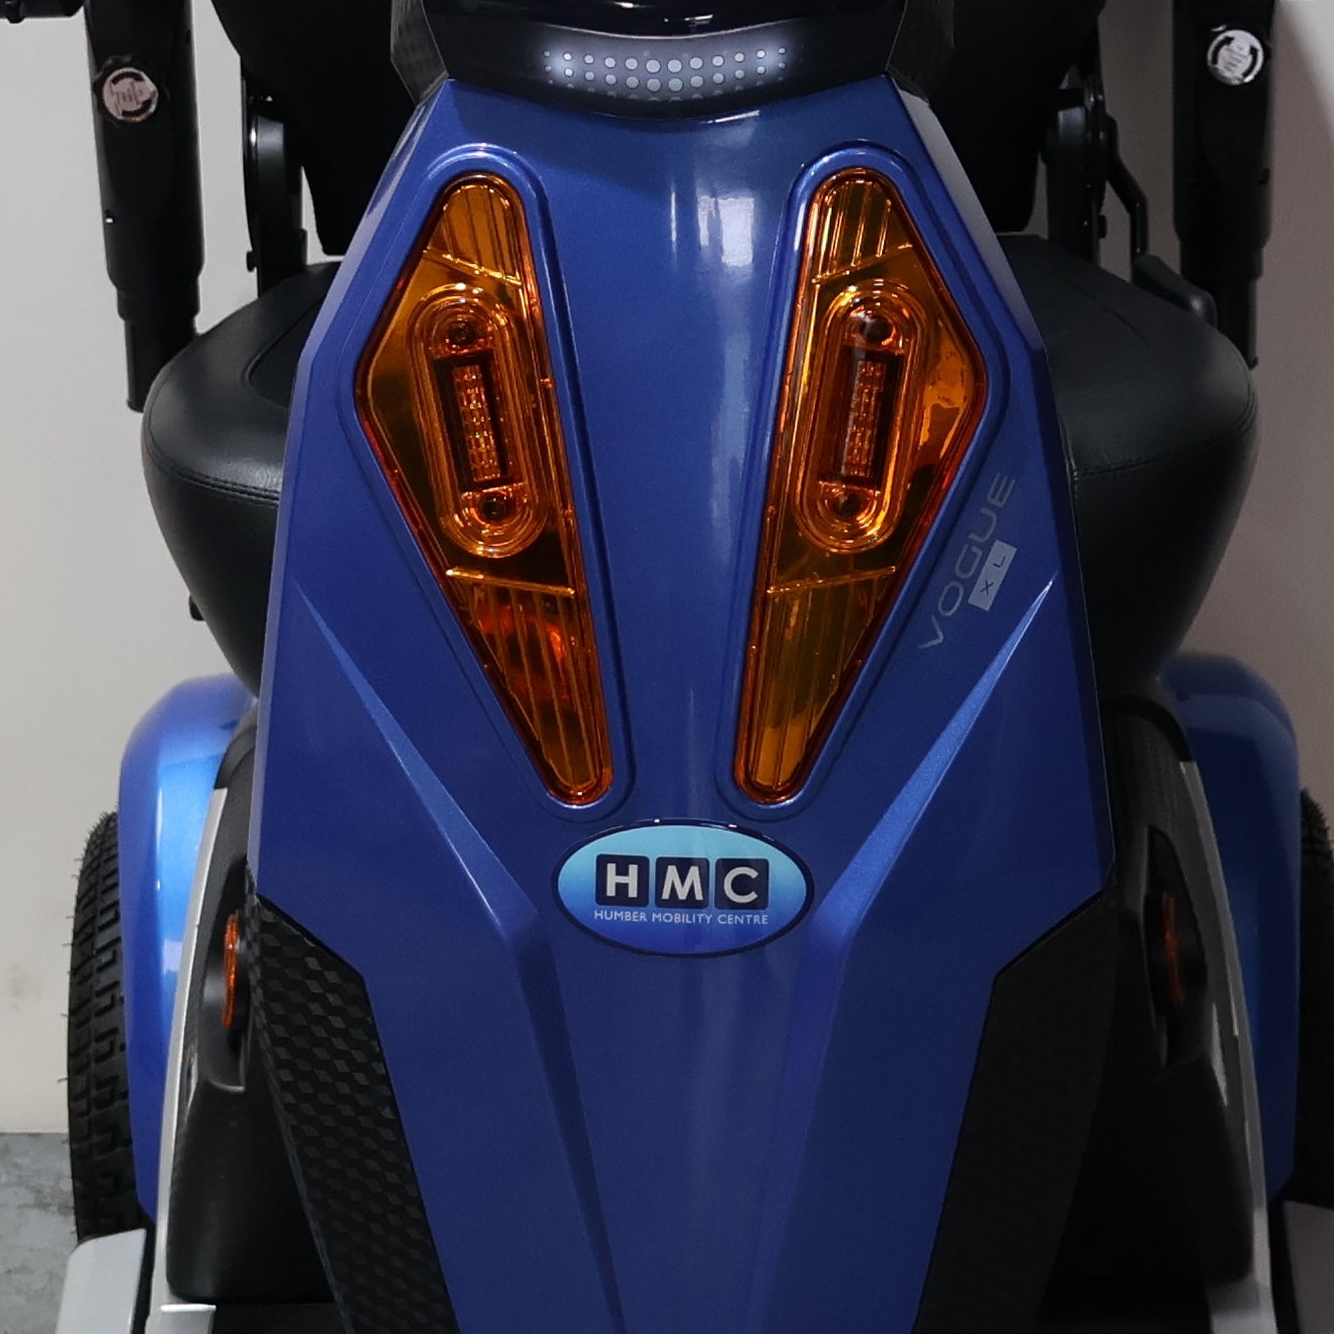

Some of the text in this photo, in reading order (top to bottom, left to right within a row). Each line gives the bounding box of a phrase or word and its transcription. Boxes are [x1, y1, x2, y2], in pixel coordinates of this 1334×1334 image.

[918, 473, 1016, 649] VOGUE
[979, 555, 1007, 596] XL
[605, 862, 759, 904] HMC
[593, 909, 769, 925] HUMBER MOBILITY CENTRE
